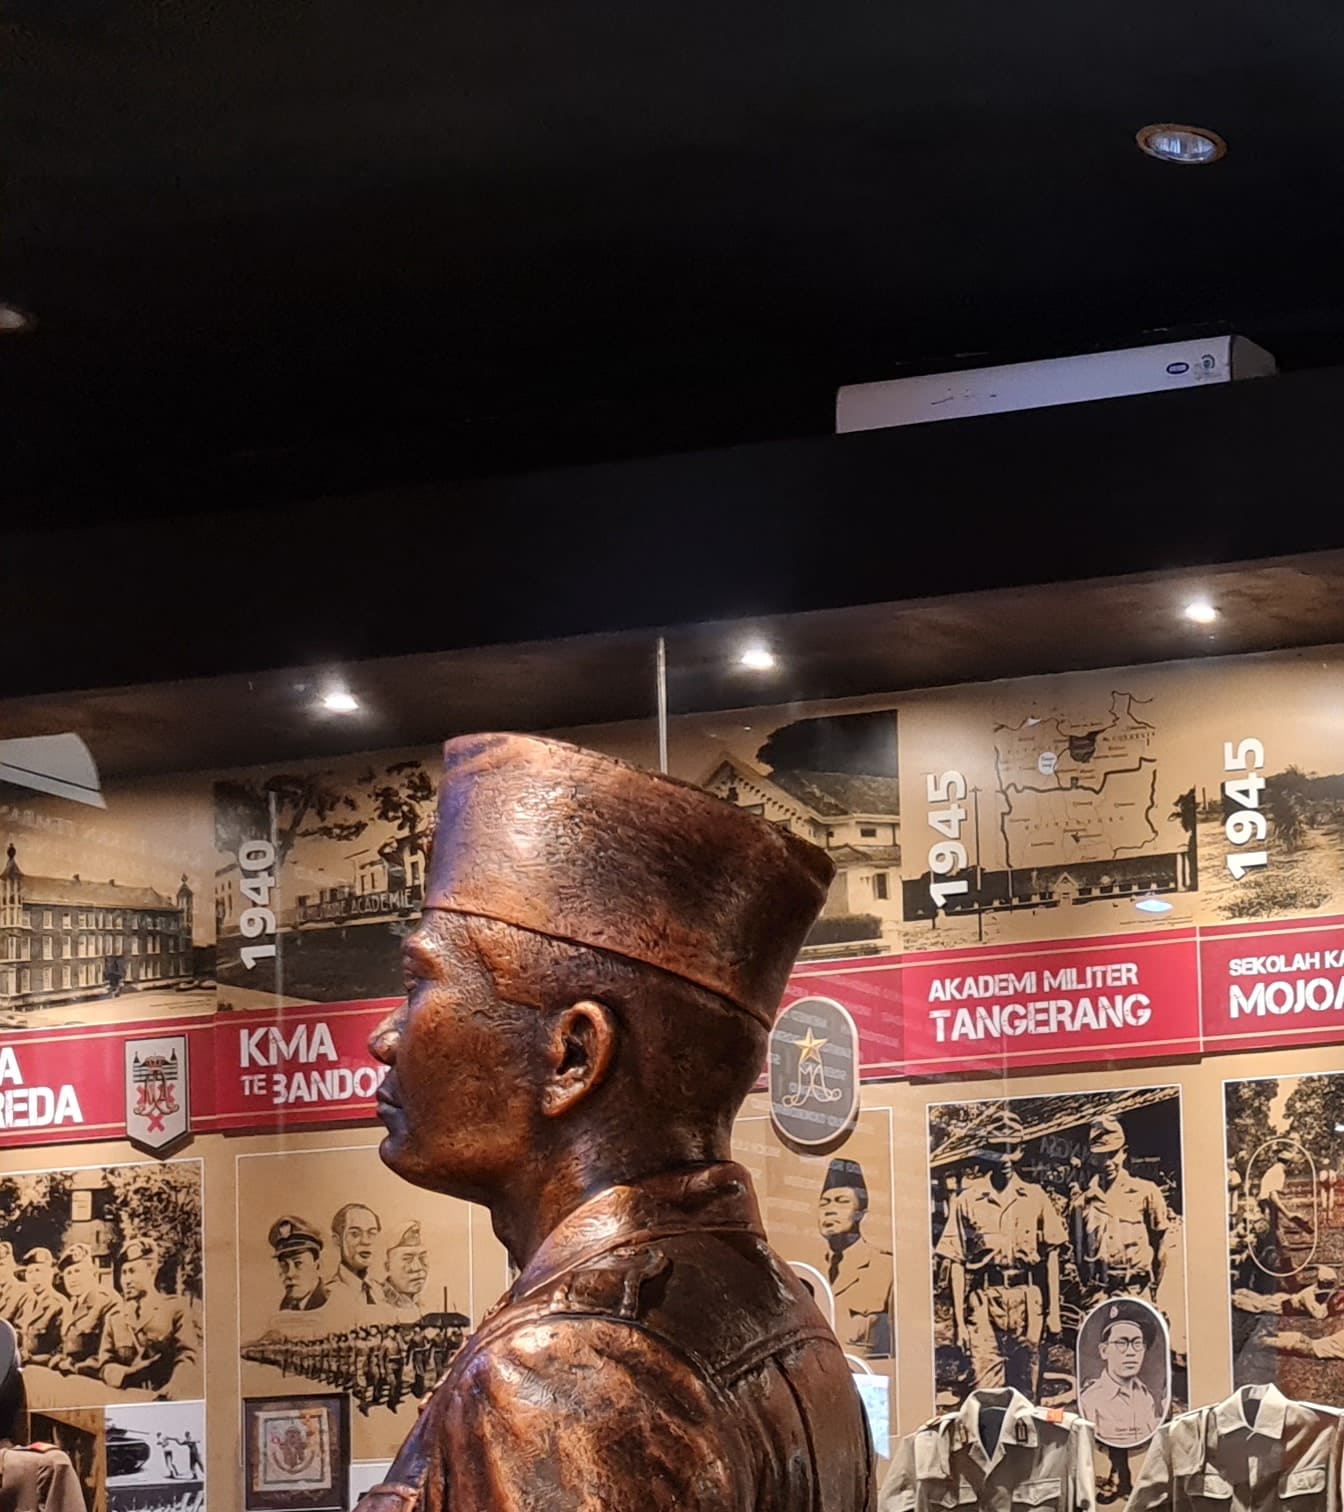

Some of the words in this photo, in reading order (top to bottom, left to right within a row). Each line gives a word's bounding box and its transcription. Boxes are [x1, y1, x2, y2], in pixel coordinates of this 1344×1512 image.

[1224, 738, 1267, 880] 1945
[927, 770, 968, 907] 1945
[238, 839, 276, 970] 1940
[928, 970, 1037, 1003] AKADEMI
[1044, 962, 1139, 993] MILITER
[1229, 952, 1320, 976] SEKOLAH
[929, 993, 1152, 1043] TANGERANG
[240, 1023, 338, 1067] KMA
[241, 1074, 267, 1095] TE
